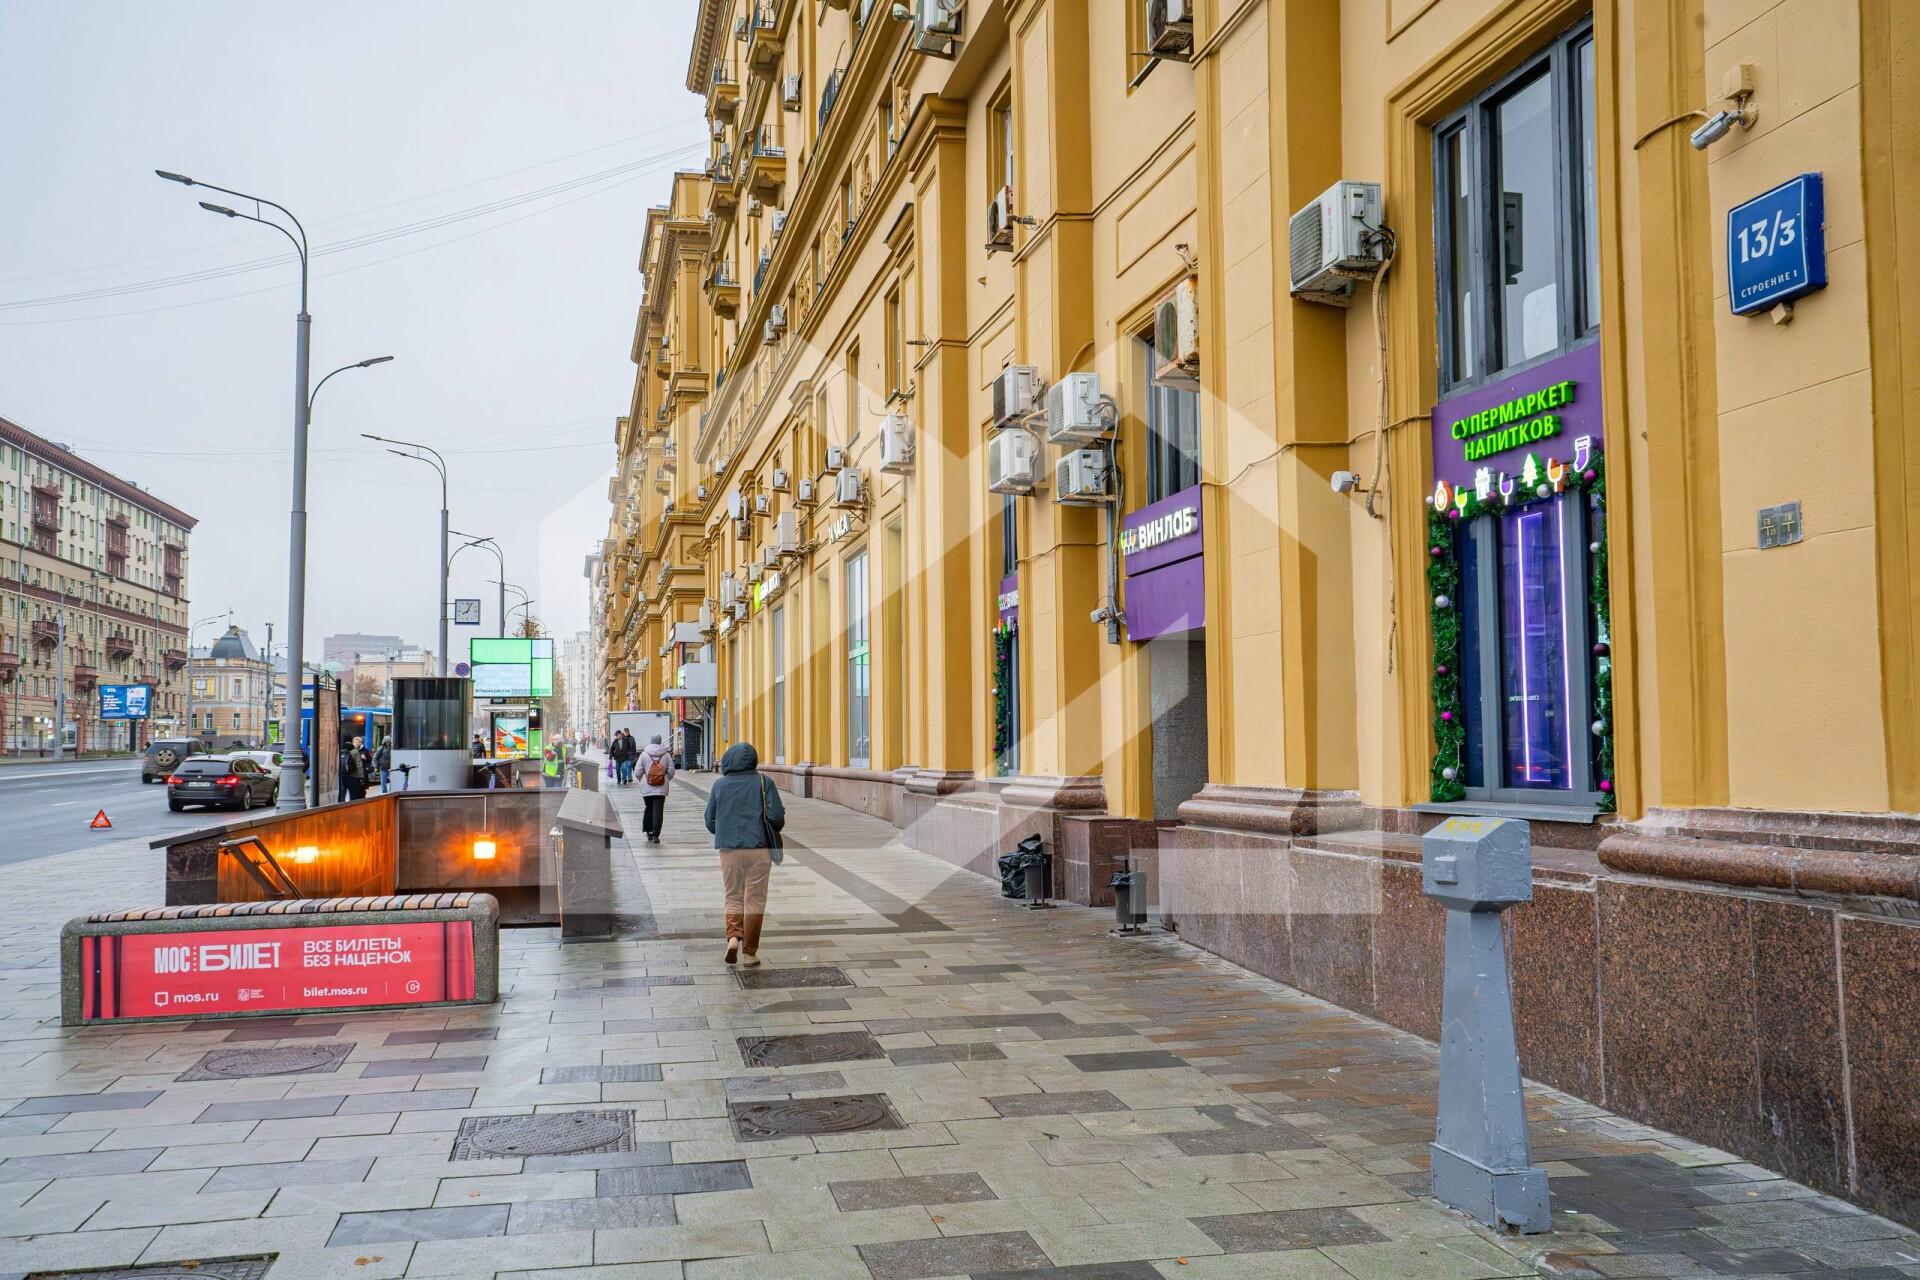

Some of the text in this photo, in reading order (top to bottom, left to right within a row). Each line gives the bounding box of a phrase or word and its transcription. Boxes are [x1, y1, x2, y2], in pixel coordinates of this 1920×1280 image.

[1738, 210, 1796, 264] 13/3
[1741, 269, 1798, 298] СТРОЕНИЕ 1
[1451, 380, 1573, 441] СУПЕРМАРКЕТ
[1464, 415, 1558, 461] НАПИТКОВ
[154, 942, 281, 973] МОС БИЛЕТ
[303, 937, 401, 953] ВСЕ БИЛЕТЫ
[303, 951, 412, 967] БЕЗ НАЦЕНОК
[173, 992, 219, 1003] mos.ru
[303, 986, 368, 997] bilet.mos.ru
